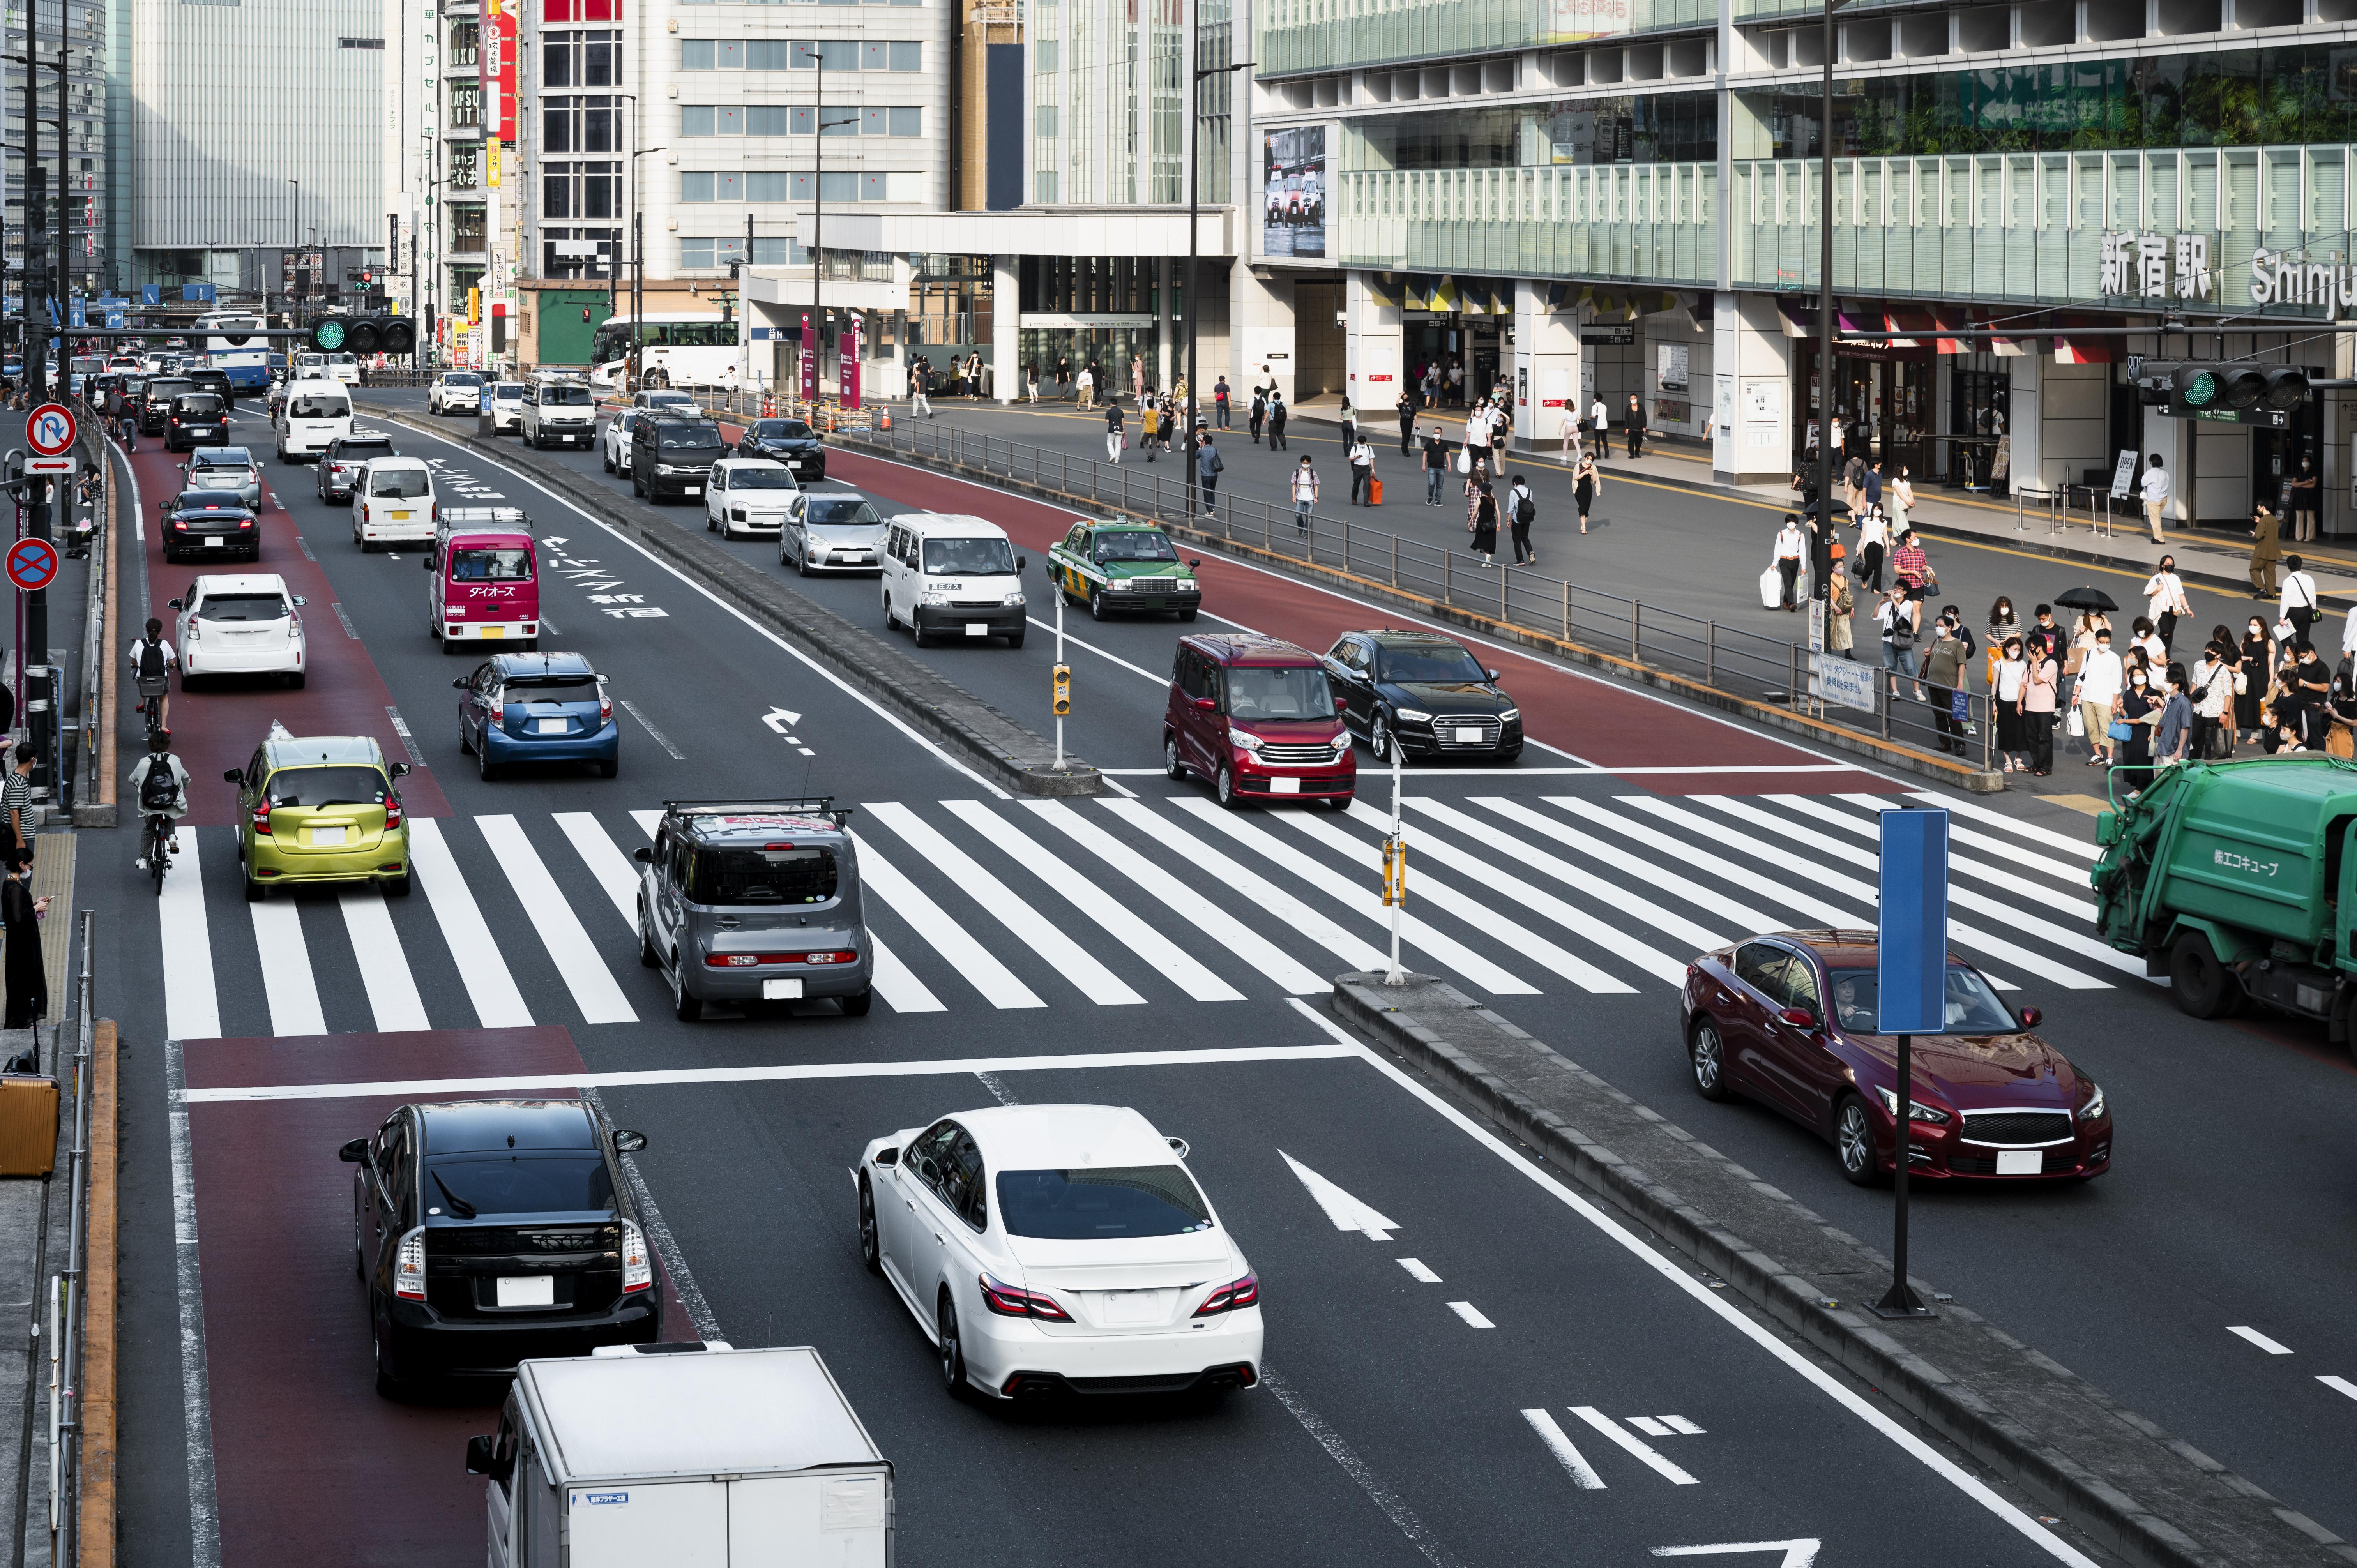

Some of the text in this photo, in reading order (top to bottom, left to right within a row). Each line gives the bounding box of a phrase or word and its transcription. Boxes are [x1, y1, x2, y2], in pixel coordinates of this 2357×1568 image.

[2100, 230, 2213, 299] 新宿駅
[777, 331, 783, 339] H
[2119, 457, 2134, 470] OPEN
[470, 587, 516, 597] ダイオーズ
[549, 559, 670, 618] バスタ新宿
